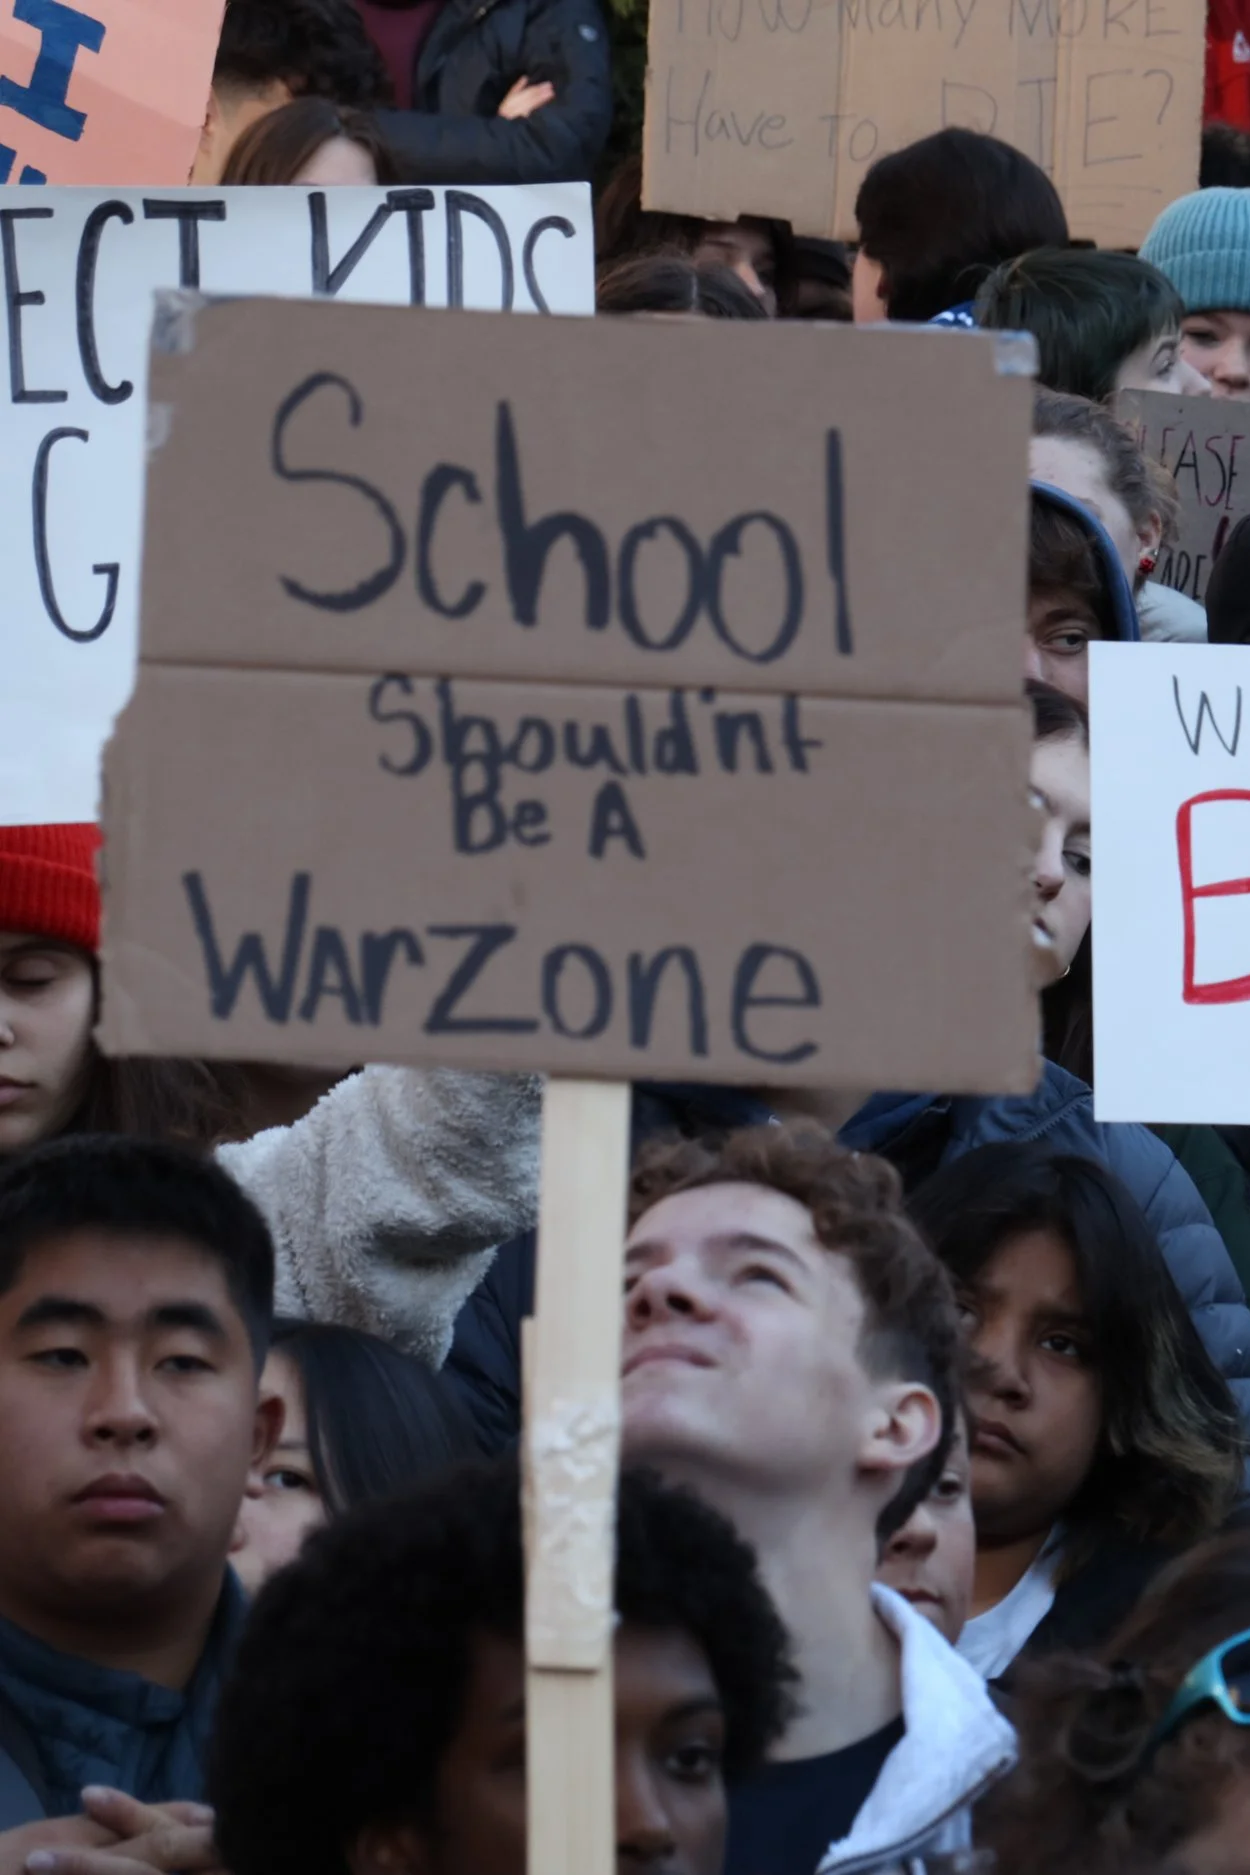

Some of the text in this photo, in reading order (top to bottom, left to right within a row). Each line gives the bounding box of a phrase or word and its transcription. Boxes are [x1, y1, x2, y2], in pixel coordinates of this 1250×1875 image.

[665, 65, 794, 157] Have
[270, 371, 855, 664] School
[452, 753, 647, 861] Be A
